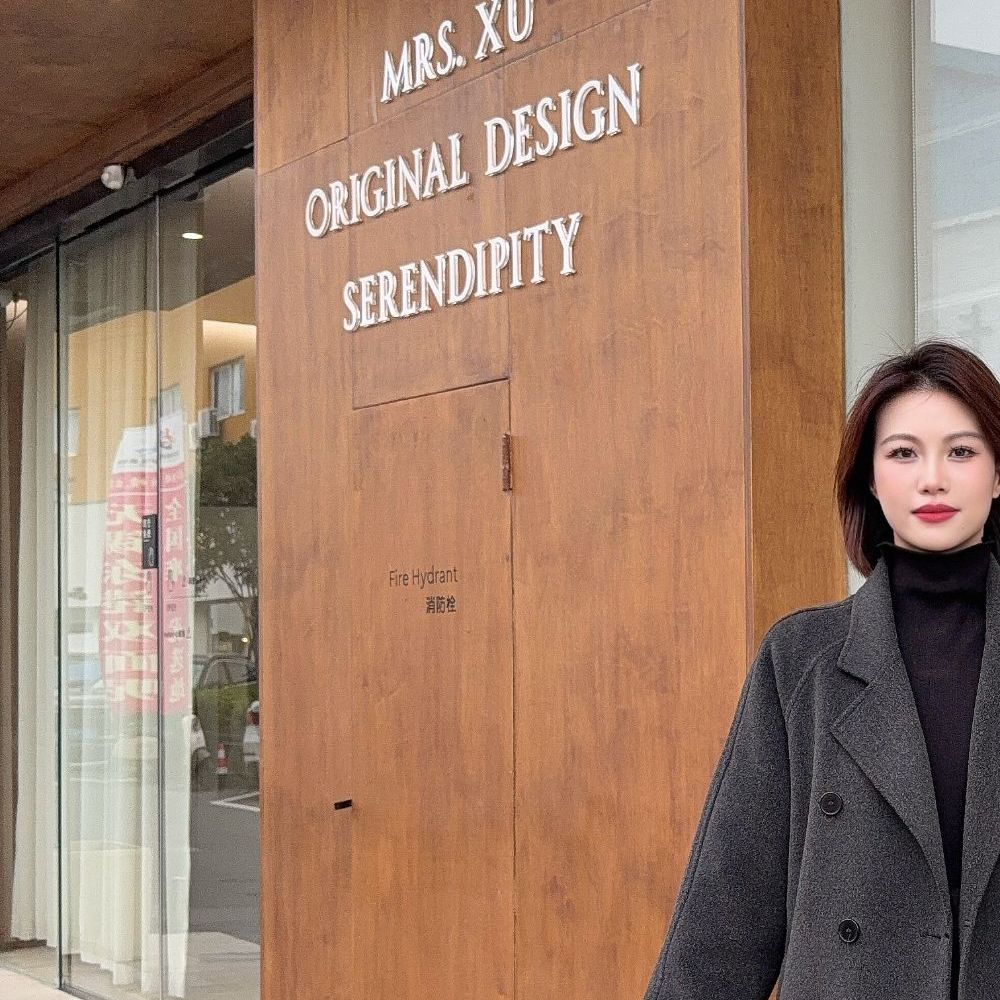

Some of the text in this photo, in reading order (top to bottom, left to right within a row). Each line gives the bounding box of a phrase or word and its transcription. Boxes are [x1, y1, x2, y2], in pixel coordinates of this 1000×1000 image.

[380, 0, 534, 104] MRS. XU
[305, 63, 643, 238] ORIGINAL DESIGN
[343, 212, 583, 332] SERENDIPITY
[389, 565, 458, 589] Fire Hydrant
[426, 595, 456, 614] 消防栓
